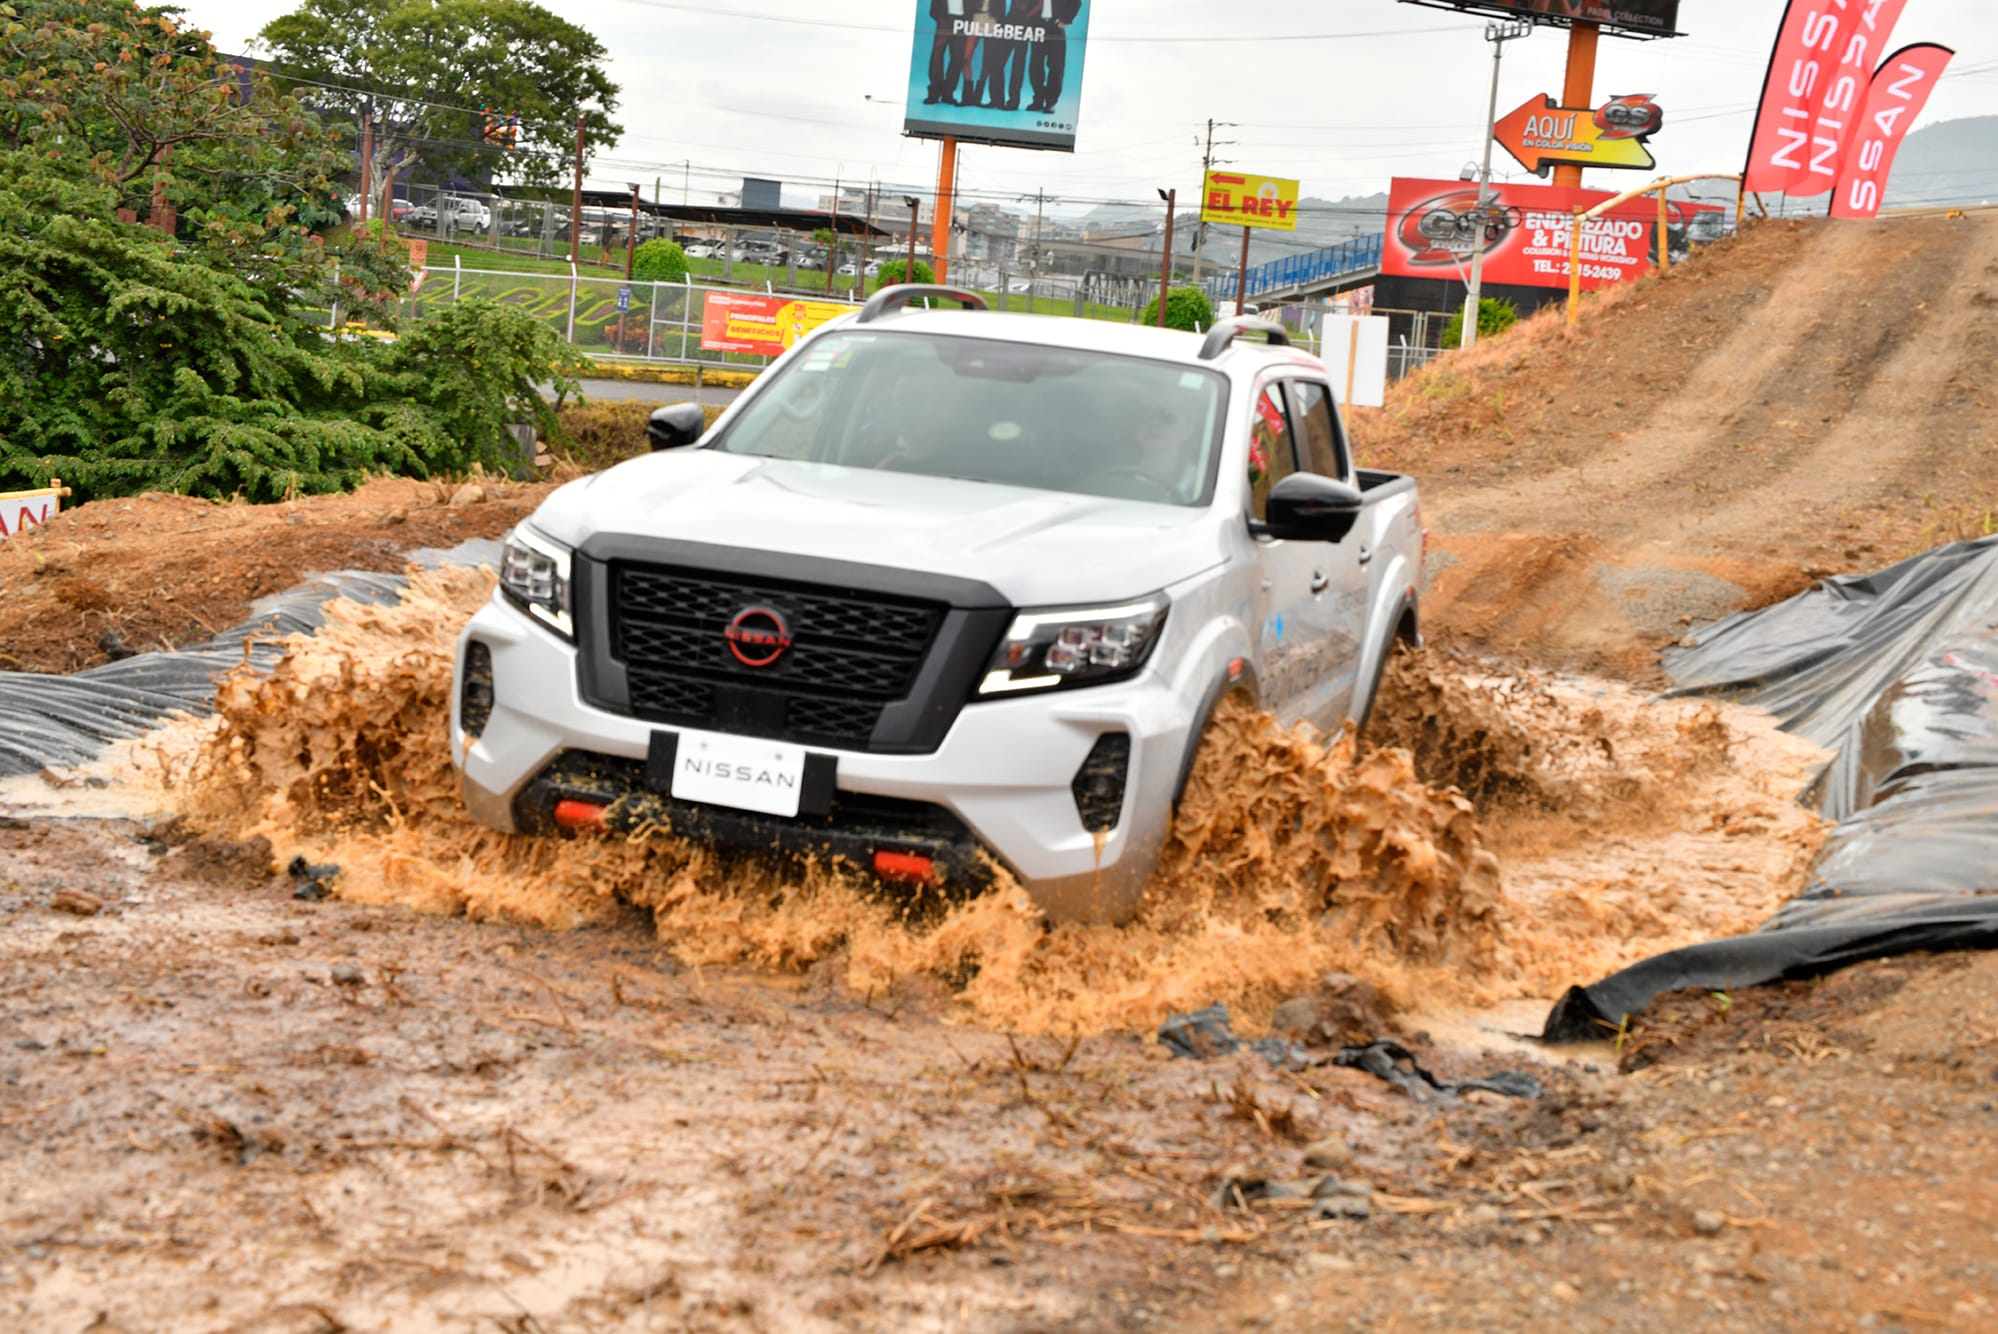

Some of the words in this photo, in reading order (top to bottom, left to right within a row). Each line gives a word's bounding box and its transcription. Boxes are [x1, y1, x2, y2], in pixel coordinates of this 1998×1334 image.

[952, 19, 1046, 43] PULL&BEAR
[1770, 0, 1848, 171] NISS
[1604, 103, 1652, 126] GS
[1522, 113, 1577, 141] AQUÍ
[1522, 139, 1535, 148] EN
[1535, 140, 1564, 150] COLOR
[1208, 191, 1235, 213] EL
[1242, 195, 1294, 219] REY
[1531, 229, 1549, 248] &
[1561, 261, 1622, 280] 215-2439
[729, 312, 776, 324] PRINCIPALES
[730, 326, 781, 337] BENEFICIOS
[684, 757, 796, 789] NISSAN
